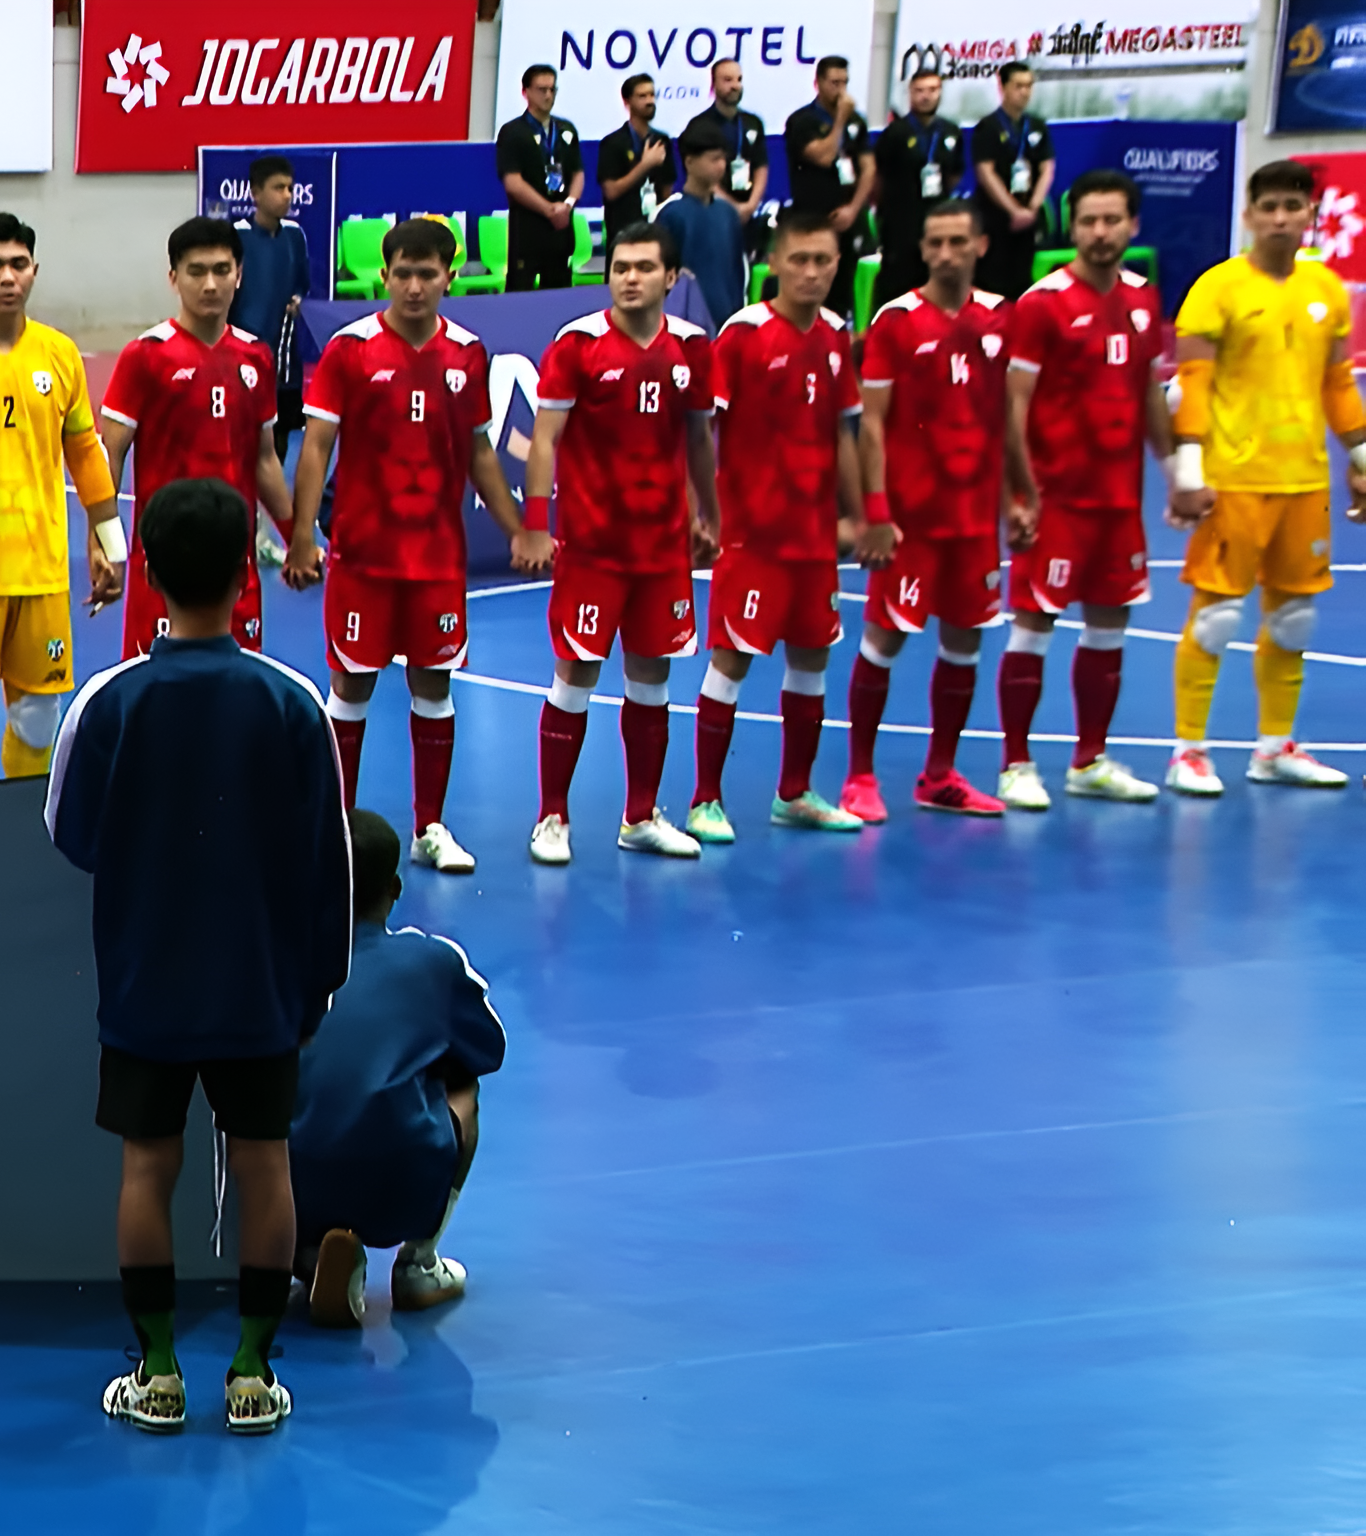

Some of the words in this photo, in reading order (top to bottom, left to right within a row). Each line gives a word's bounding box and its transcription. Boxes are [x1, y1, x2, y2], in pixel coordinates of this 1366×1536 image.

[560, 25, 816, 70] NOVOTEL
[181, 35, 454, 107] JOGARBOLA
[1105, 333, 1128, 366] 10
[3, 396, 16, 428] 2
[211, 386, 226, 418] 8
[410, 390, 425, 423] 9
[639, 380, 661, 413] 13
[743, 589, 760, 620] 6
[899, 576, 921, 607] 14
[347, 611, 361, 642] 9
[577, 603, 600, 635] 13
